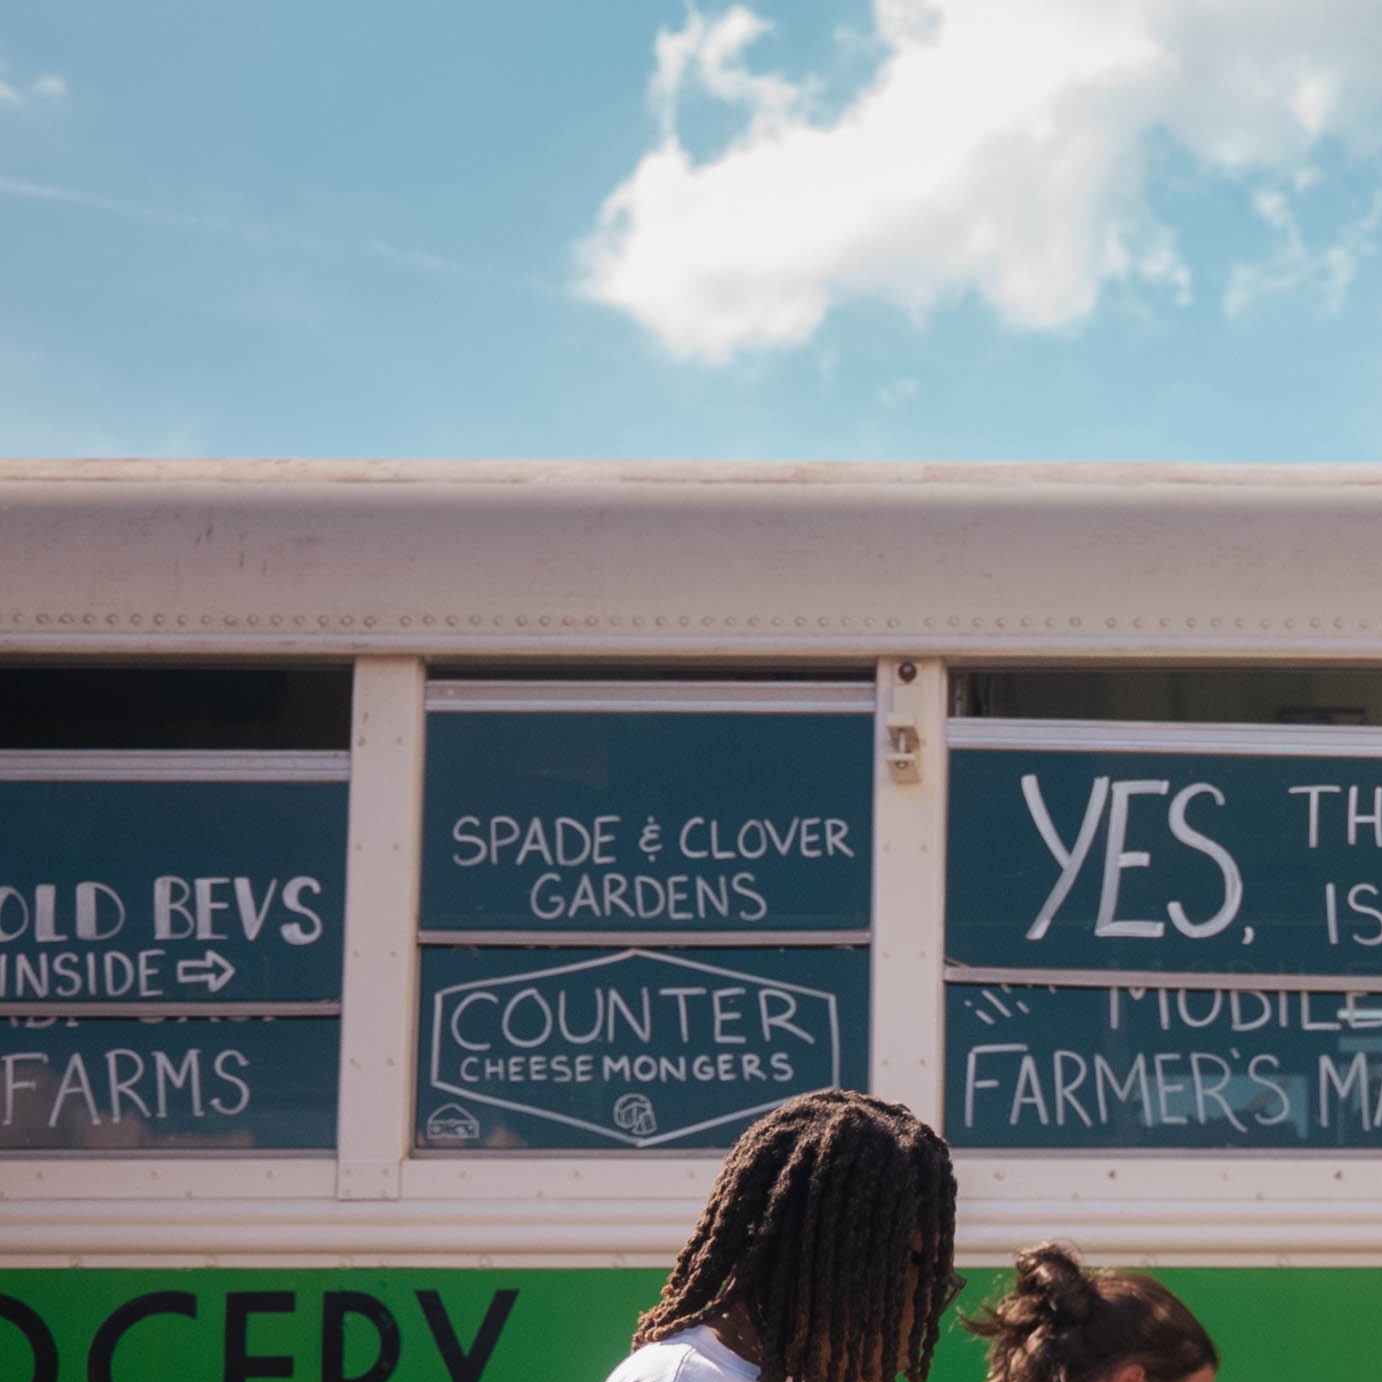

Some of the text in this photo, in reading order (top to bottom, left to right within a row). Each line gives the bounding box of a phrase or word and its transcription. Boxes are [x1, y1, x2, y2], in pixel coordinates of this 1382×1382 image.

[451, 814, 855, 867] SPADE & CLOVER
[1020, 773, 1255, 946] YES,
[0, 875, 324, 946] OLD BEVS
[530, 871, 768, 921] GARDENS
[0, 948, 166, 998] INSIDE
[451, 986, 816, 1051] COUNTER
[0, 1048, 250, 1127] FARMS
[963, 1041, 1293, 1132] FARMER'S
